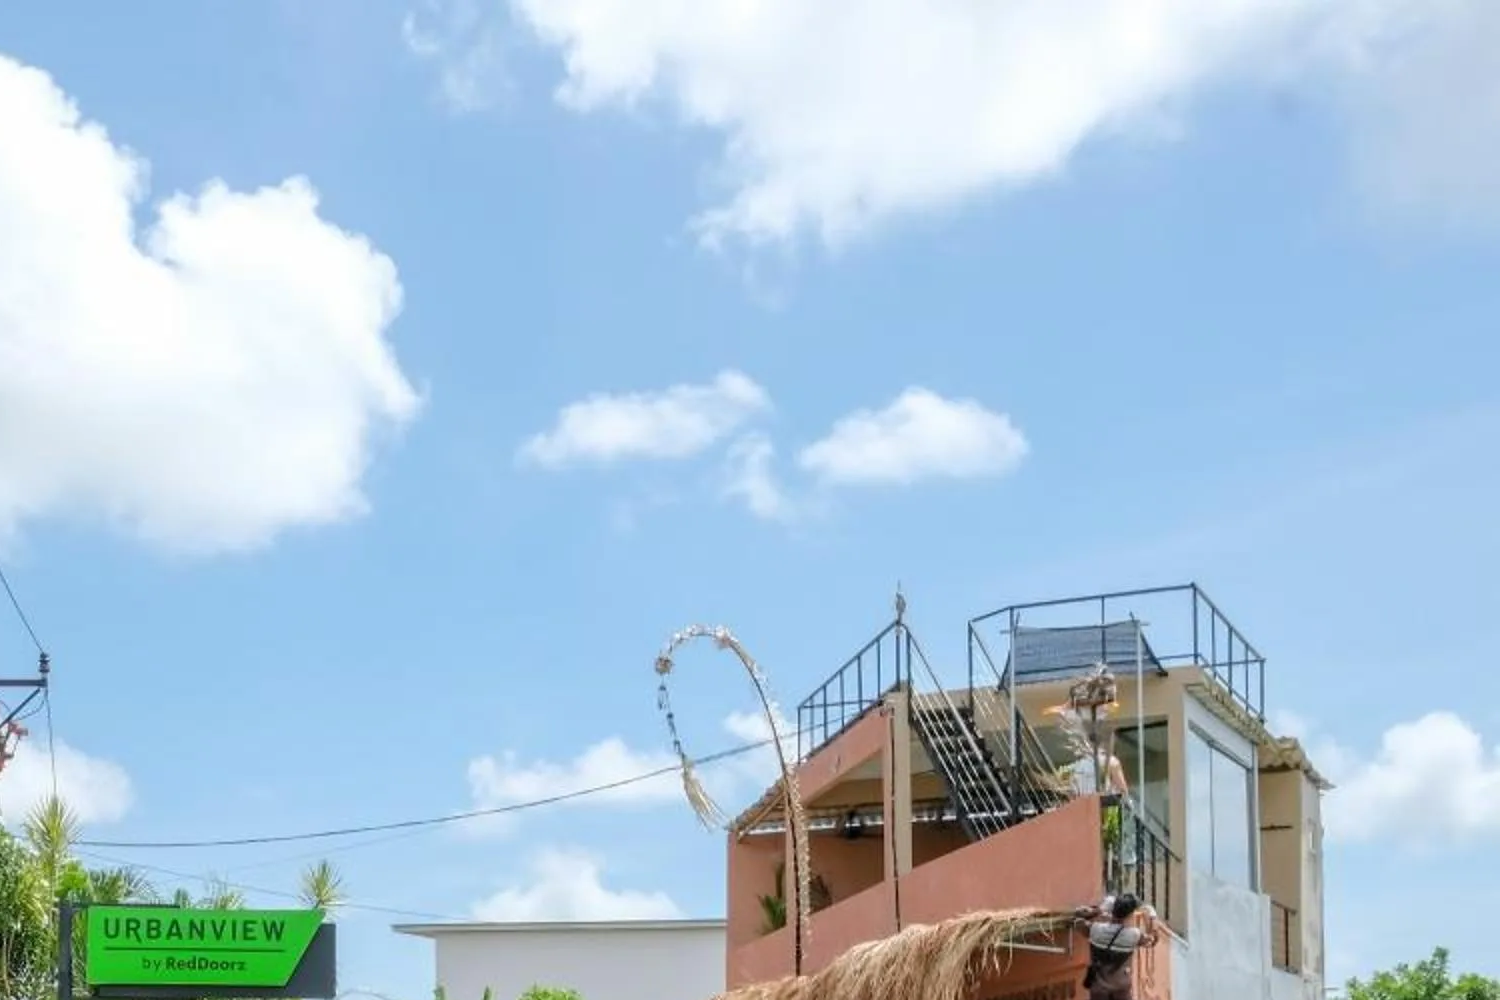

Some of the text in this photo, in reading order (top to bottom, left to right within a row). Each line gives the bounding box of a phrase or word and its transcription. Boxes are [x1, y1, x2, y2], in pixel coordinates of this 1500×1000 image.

[103, 917, 285, 942] URBANVIEW
[143, 955, 247, 972] by RedDoorz
